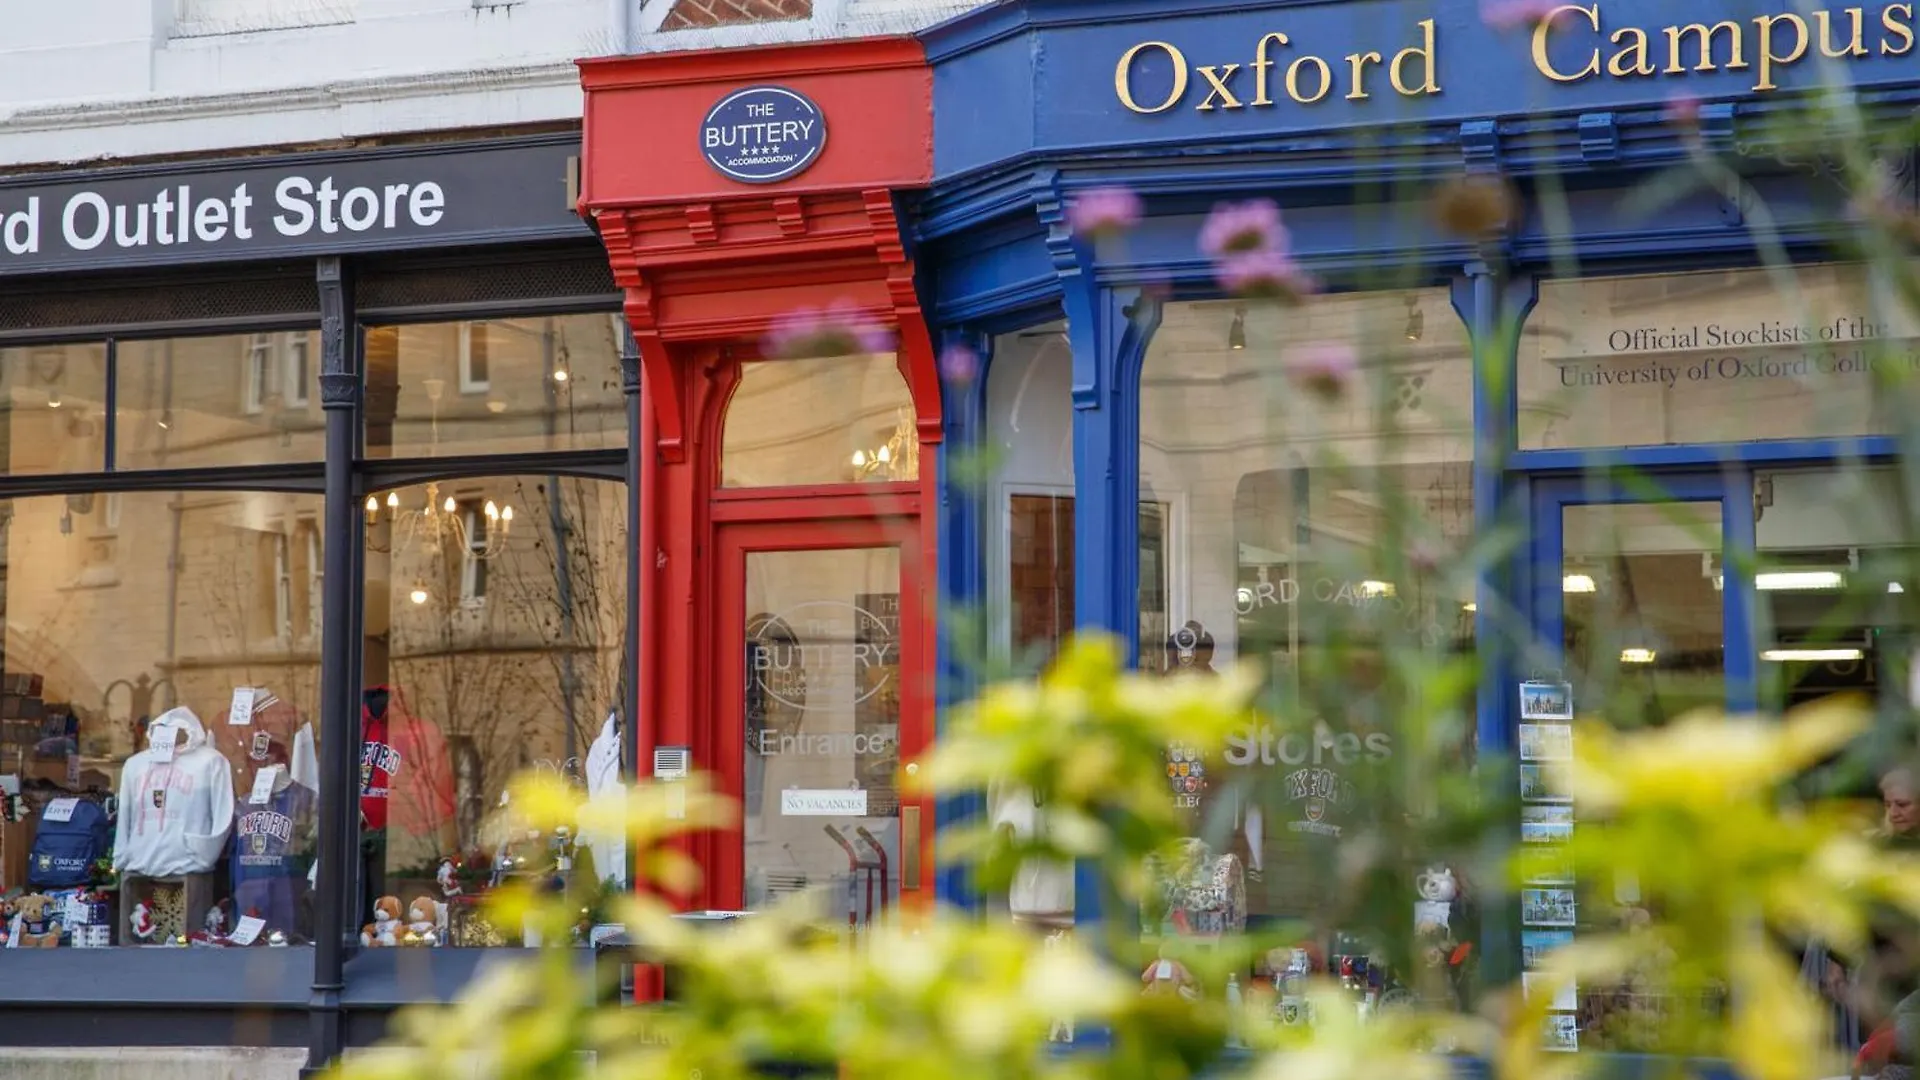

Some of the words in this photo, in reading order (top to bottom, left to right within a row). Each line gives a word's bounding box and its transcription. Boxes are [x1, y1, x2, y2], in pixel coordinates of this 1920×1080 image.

[1114, 18, 1442, 114] Oxford
[1531, 2, 1915, 91] Campus
[746, 103, 775, 117] THE
[705, 119, 815, 148] BUTTERY
[727, 154, 793, 166] ACCOMMODATION
[0, 196, 39, 255] d
[62, 182, 253, 250] Outlet
[273, 176, 445, 237] Store
[1608, 326, 1698, 351] Official
[1706, 321, 1812, 346] Stockists
[1818, 317, 1848, 341] of
[1850, 316, 1889, 339] the
[1560, 361, 1680, 391] University
[1687, 358, 1715, 381] of
[1718, 353, 1807, 380] Oxford
[755, 642, 892, 671] BUTTERY
[759, 728, 886, 756] Entrance
[1223, 721, 1393, 766] Stores
[787, 799, 804, 809] NO
[807, 799, 862, 810] VACANCIES
